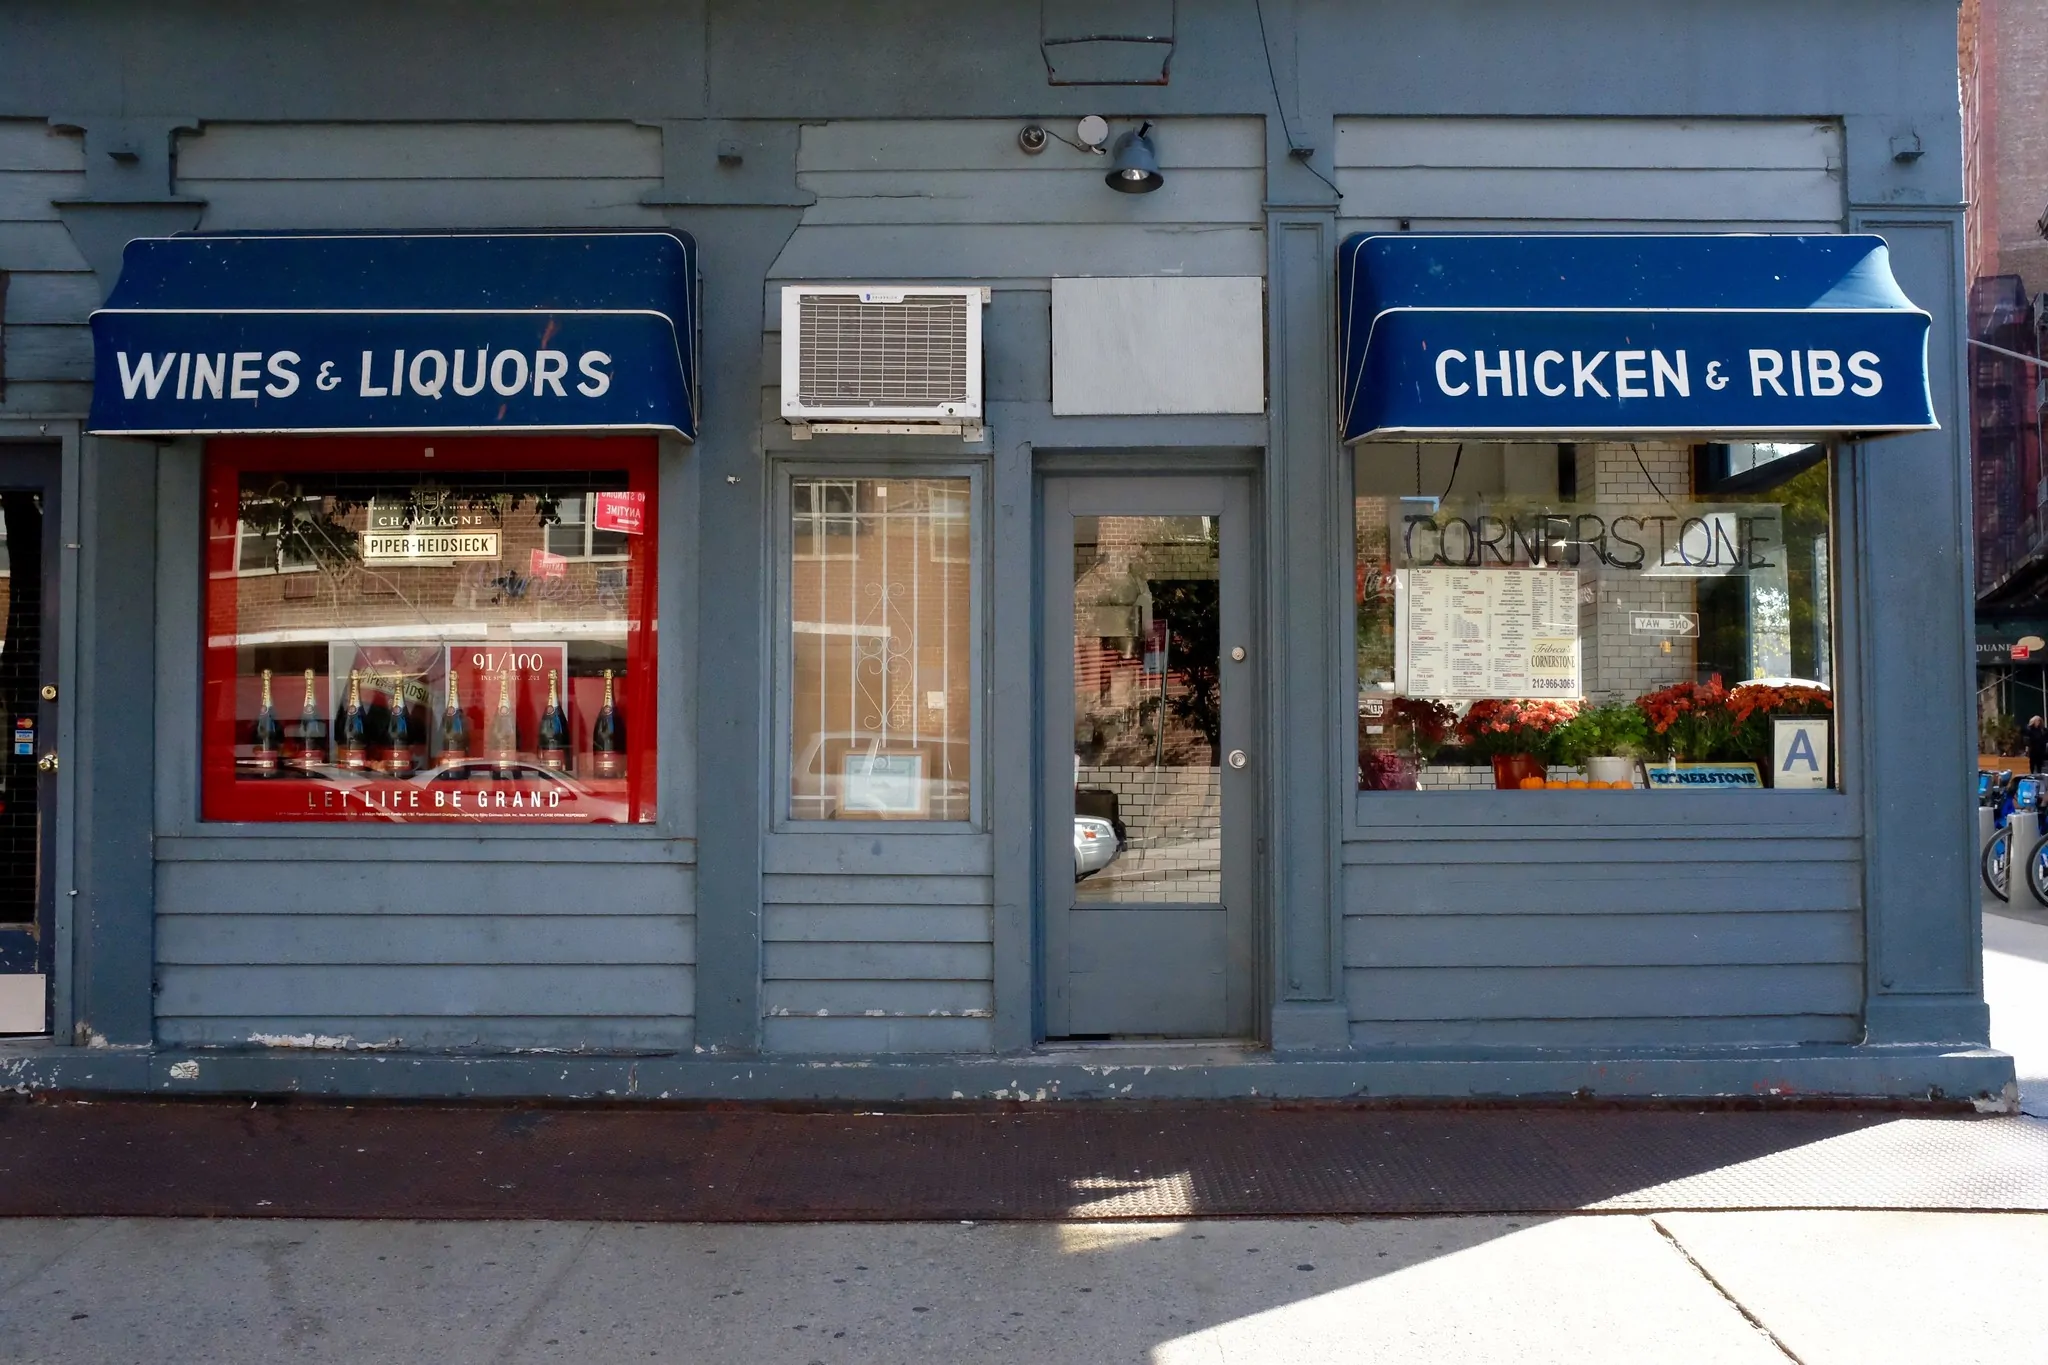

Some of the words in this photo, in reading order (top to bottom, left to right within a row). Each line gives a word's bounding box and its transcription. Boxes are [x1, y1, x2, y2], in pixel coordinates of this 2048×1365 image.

[116, 350, 301, 399] WINES
[315, 360, 342, 391] &
[359, 348, 613, 400] LIQUORS
[1434, 348, 1691, 398] CHICKEN
[1705, 360, 1730, 391] &
[1748, 348, 1884, 398] RIBS
[378, 515, 483, 526] CHAMPAGNE
[370, 537, 490, 553] PIPER-HEIDSIECK
[1404, 513, 1776, 570] CORNERSTONE
[472, 652, 544, 672] 91/100
[1531, 655, 1576, 669] CORNERSTONE
[1781, 728, 1820, 772] A
[308, 791, 350, 808] LET
[365, 790, 419, 808] LIFE
[434, 790, 462, 808] BE
[477, 790, 560, 808] GRAND
